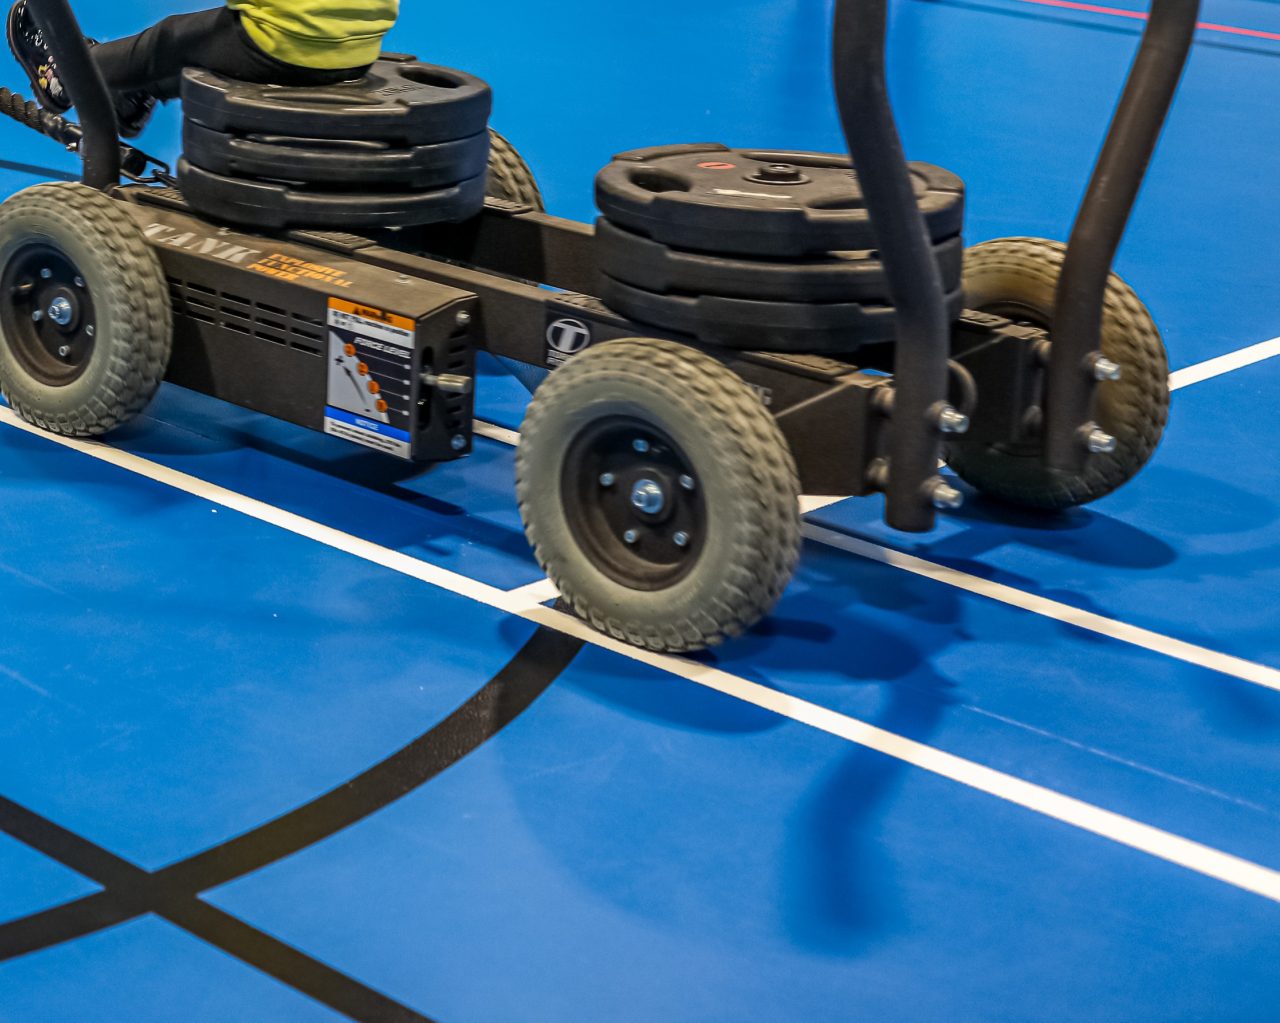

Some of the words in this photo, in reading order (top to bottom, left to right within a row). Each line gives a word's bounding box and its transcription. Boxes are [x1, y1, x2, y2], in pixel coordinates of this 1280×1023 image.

[144, 223, 261, 263] TANK
[354, 336, 384, 351] FORCE
[382, 345, 411, 359] LEVEL
